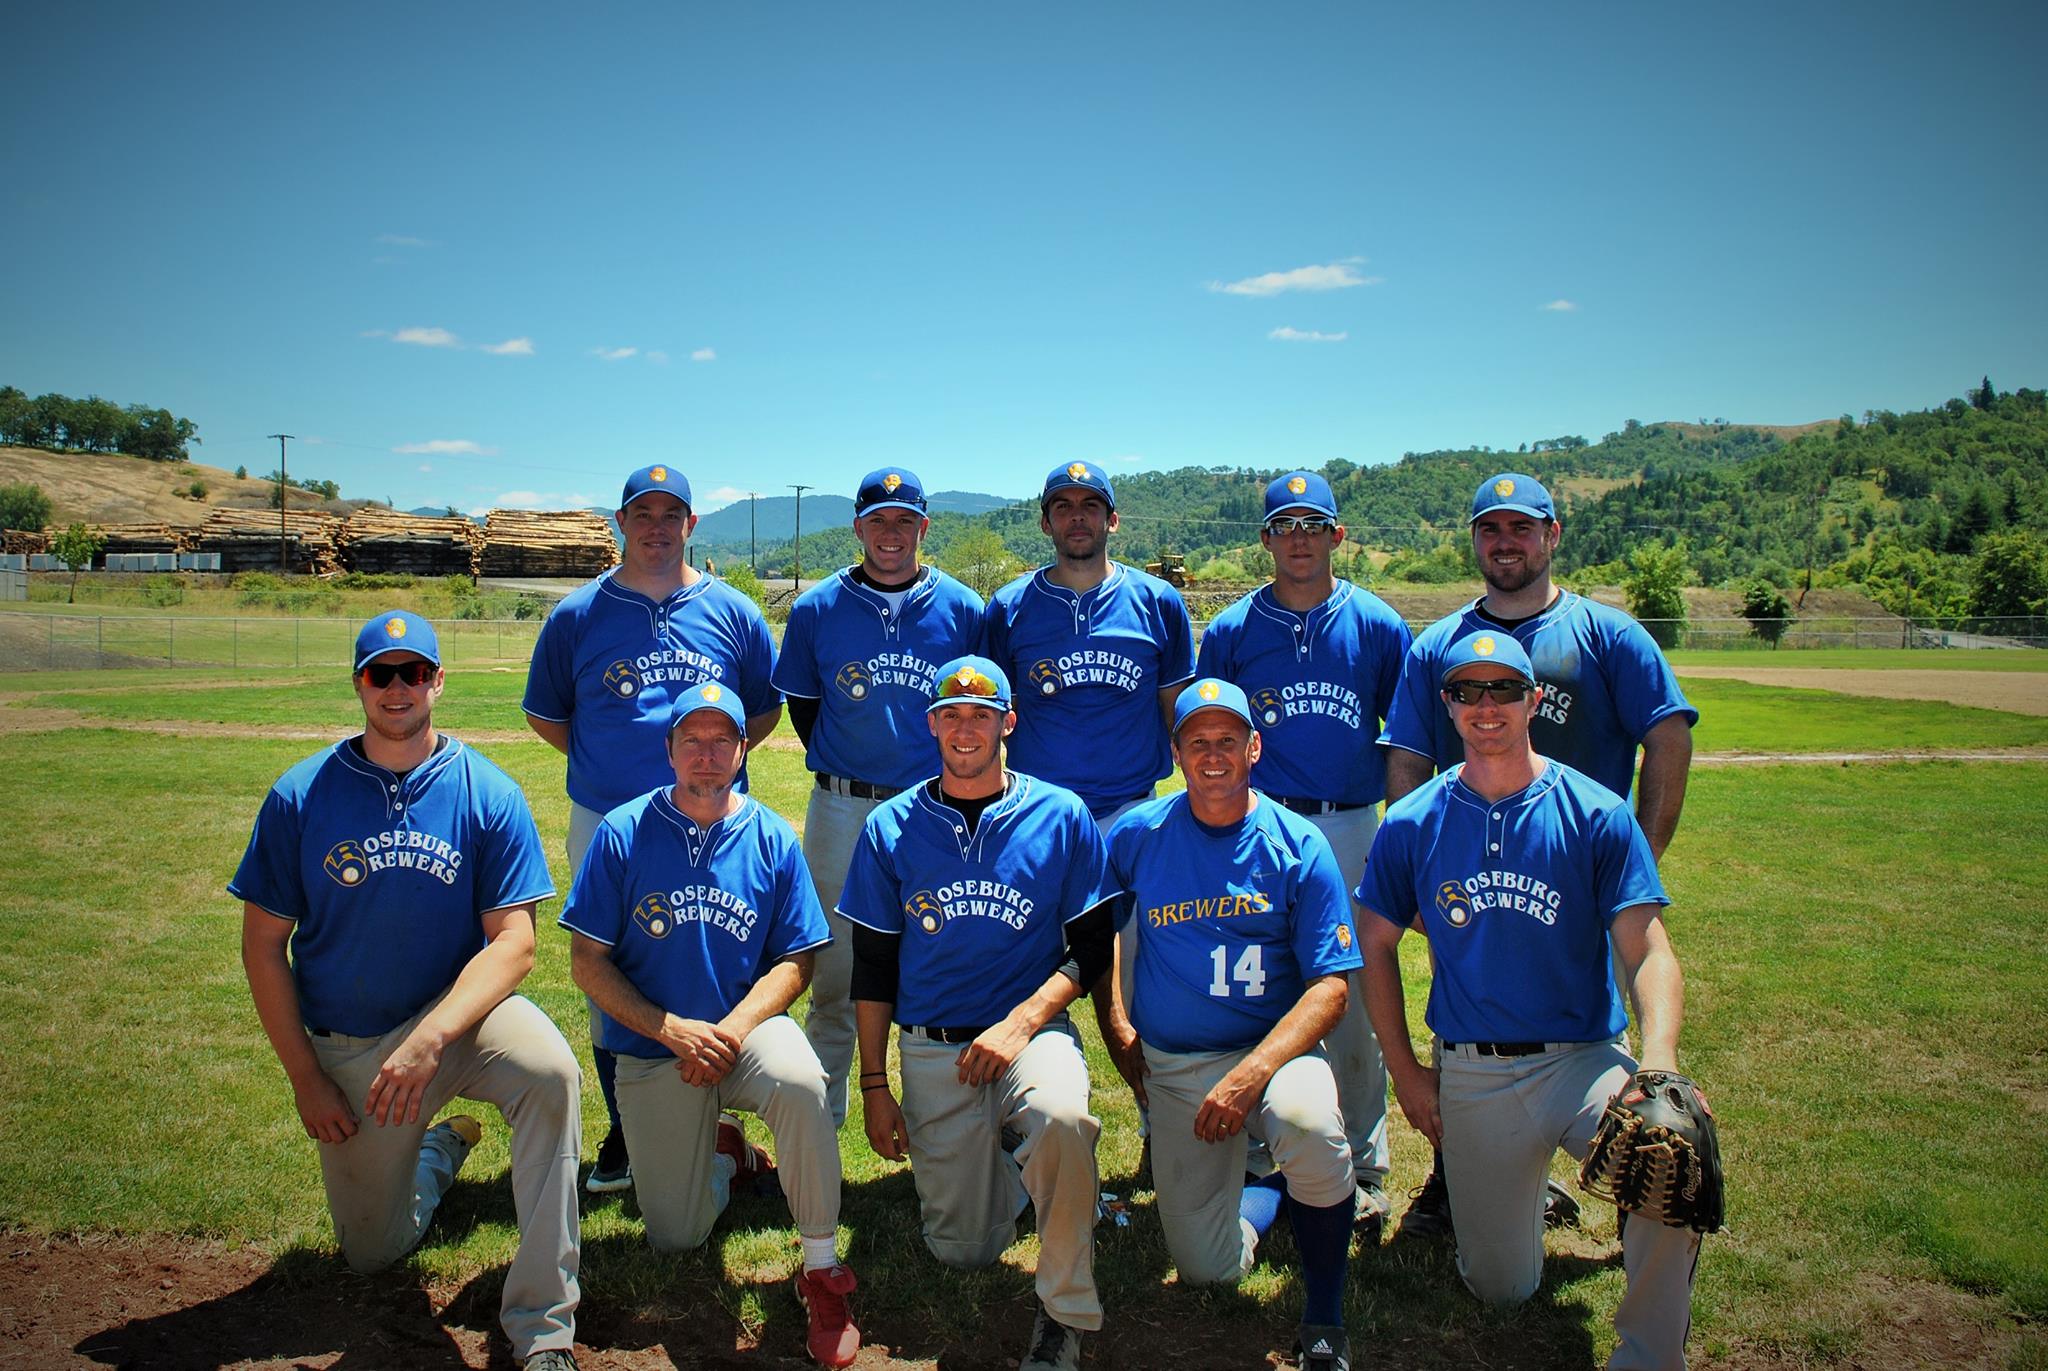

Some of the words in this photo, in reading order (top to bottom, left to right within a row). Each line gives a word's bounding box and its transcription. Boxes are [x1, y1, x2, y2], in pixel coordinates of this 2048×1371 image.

[636, 649, 723, 680] OSEBURG
[640, 667, 712, 687] REWER
[867, 652, 938, 680] OSEBUR
[1058, 650, 1143, 680] OSEBURG
[1062, 668, 1138, 692] REWERS
[871, 670, 935, 698] REWER
[1284, 699, 1361, 729] REWERS
[363, 830, 463, 869] OSEBURG
[367, 851, 458, 885] REWERS
[670, 885, 758, 928] OSEBURG
[937, 880, 1034, 916] OSEBURG
[1465, 870, 1561, 910] OSEBURG
[673, 905, 751, 942] REWERS
[942, 900, 1028, 931] REWERS
[1148, 892, 1270, 928] BREWERS
[1471, 891, 1557, 926] REWERS
[1209, 944, 1266, 997] 14
